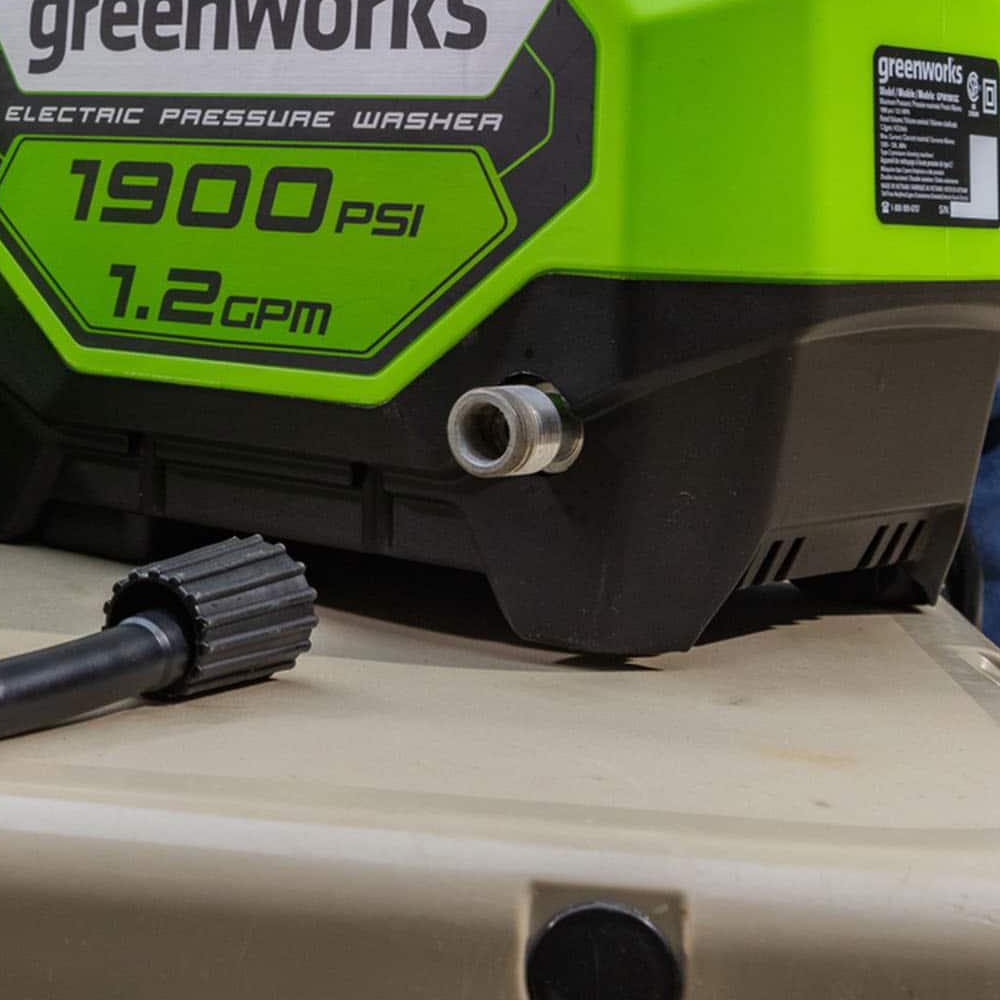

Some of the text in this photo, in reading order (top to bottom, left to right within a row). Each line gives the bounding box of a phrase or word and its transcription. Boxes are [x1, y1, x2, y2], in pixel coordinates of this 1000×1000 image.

[878, 57, 963, 85] greenworks
[5, 106, 504, 133] ELECTRIC PRESSURE WASHER
[69, 159, 425, 238] 1900 PSI
[106, 263, 333, 336] 1.2 GPM
